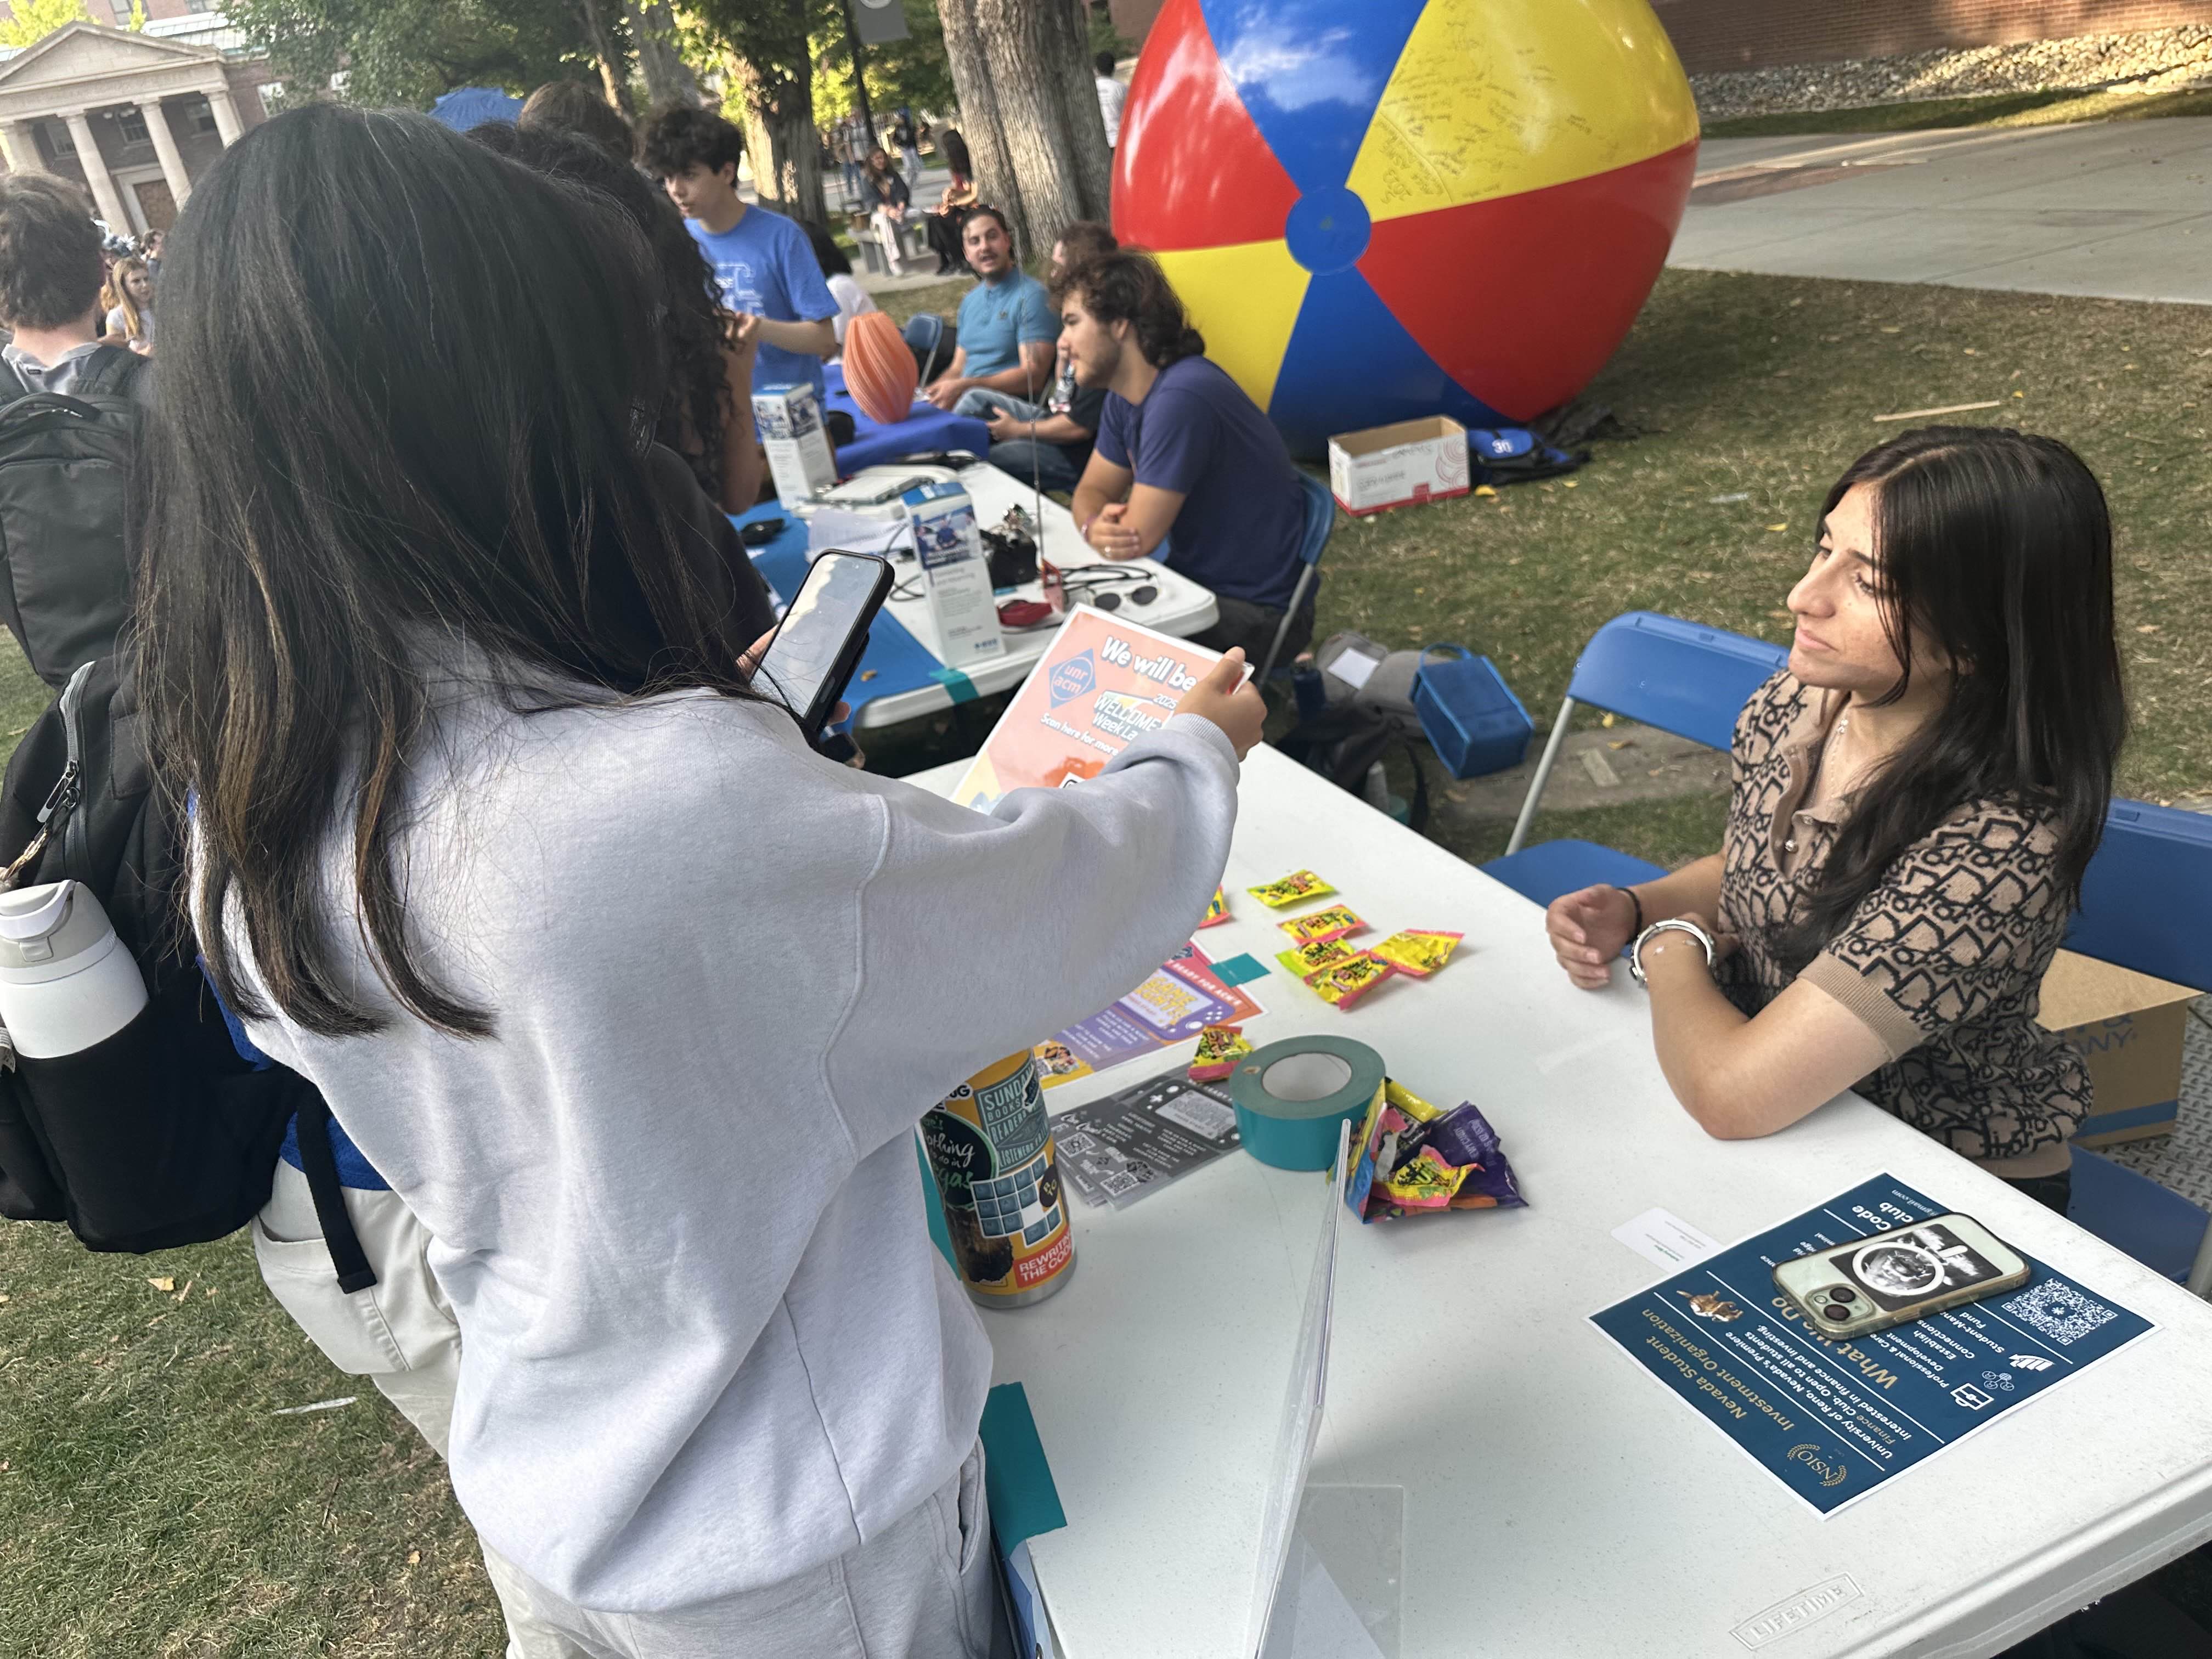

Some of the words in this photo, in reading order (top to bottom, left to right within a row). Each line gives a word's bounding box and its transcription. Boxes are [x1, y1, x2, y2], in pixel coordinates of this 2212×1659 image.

[1064, 664, 1089, 679] unr
[1101, 636, 1130, 665] We
[1133, 656, 1171, 682] will
[1169, 664, 1198, 692] be
[1054, 676, 1082, 693] acm
[1094, 695, 1161, 731] WELCOME
[1153, 693, 1178, 710] 2025
[1041, 713, 1061, 731] Scan
[1060, 722, 1081, 740] here
[1080, 731, 1096, 745] for
[1094, 740, 1119, 756] more
[1093, 712, 1124, 736] Week
[1120, 725, 1139, 741] La
[1172, 962, 1199, 981] READY
[1197, 977, 1216, 992] FOR
[985, 1065, 1031, 1110] SUNDA
[988, 1099, 1022, 1121] BOOKS
[991, 1111, 1027, 1143] READERS
[1455, 1127, 1471, 1144] CANDY
[928, 1133, 975, 1165] othing
[1465, 1142, 1480, 1159] EWY
[1852, 1205, 1891, 1237] Code
[1880, 1203, 1913, 1230] club
[1020, 1232, 1071, 1272] REWRITIN
[1814, 1229, 1836, 1249] minal
[1021, 1265, 1048, 1282] THE
[1759, 1252, 1776, 1268] ance
[1939, 1311, 2006, 1352] Student-Man
[1959, 1312, 1985, 1328] Fund
[1643, 1309, 1717, 1369] Organization
[1725, 1332, 1764, 1361] Premiere
[1745, 1331, 1783, 1359] students
[1757, 1325, 1797, 1359] investing.
[1870, 1334, 1889, 1347] Care
[1887, 1333, 1943, 1371] Development
[1914, 1330, 1956, 1359] Establish
[1917, 1320, 1974, 1358] Connections
[1646, 1336, 1696, 1378] Student
[1780, 1358, 1795, 1368] all
[1795, 1355, 1815, 1368] and
[1837, 1343, 1897, 1389] What
[1895, 1351, 1949, 1387] Professional
[1763, 1359, 1804, 1392] Nevada's
[1794, 1368, 1805, 1377] to
[1805, 1376, 1830, 1396] Open
[1814, 1368, 1850, 1395] finance
[1696, 1377, 1746, 1418] Nevada
[1717, 1369, 1794, 1430] Investment
[1806, 1390, 1831, 1412] Reno,
[1833, 1395, 1856, 1415] Club.
[1849, 1394, 1860, 1403] in
[1827, 1412, 1842, 1420] of
[1857, 1415, 1895, 1444] Finance
[1858, 1402, 1911, 1440] interested
[1841, 1420, 1892, 1458] University
[1796, 1448, 1838, 1481] NSIO
[1750, 1585, 1847, 1641] LIFETIME
